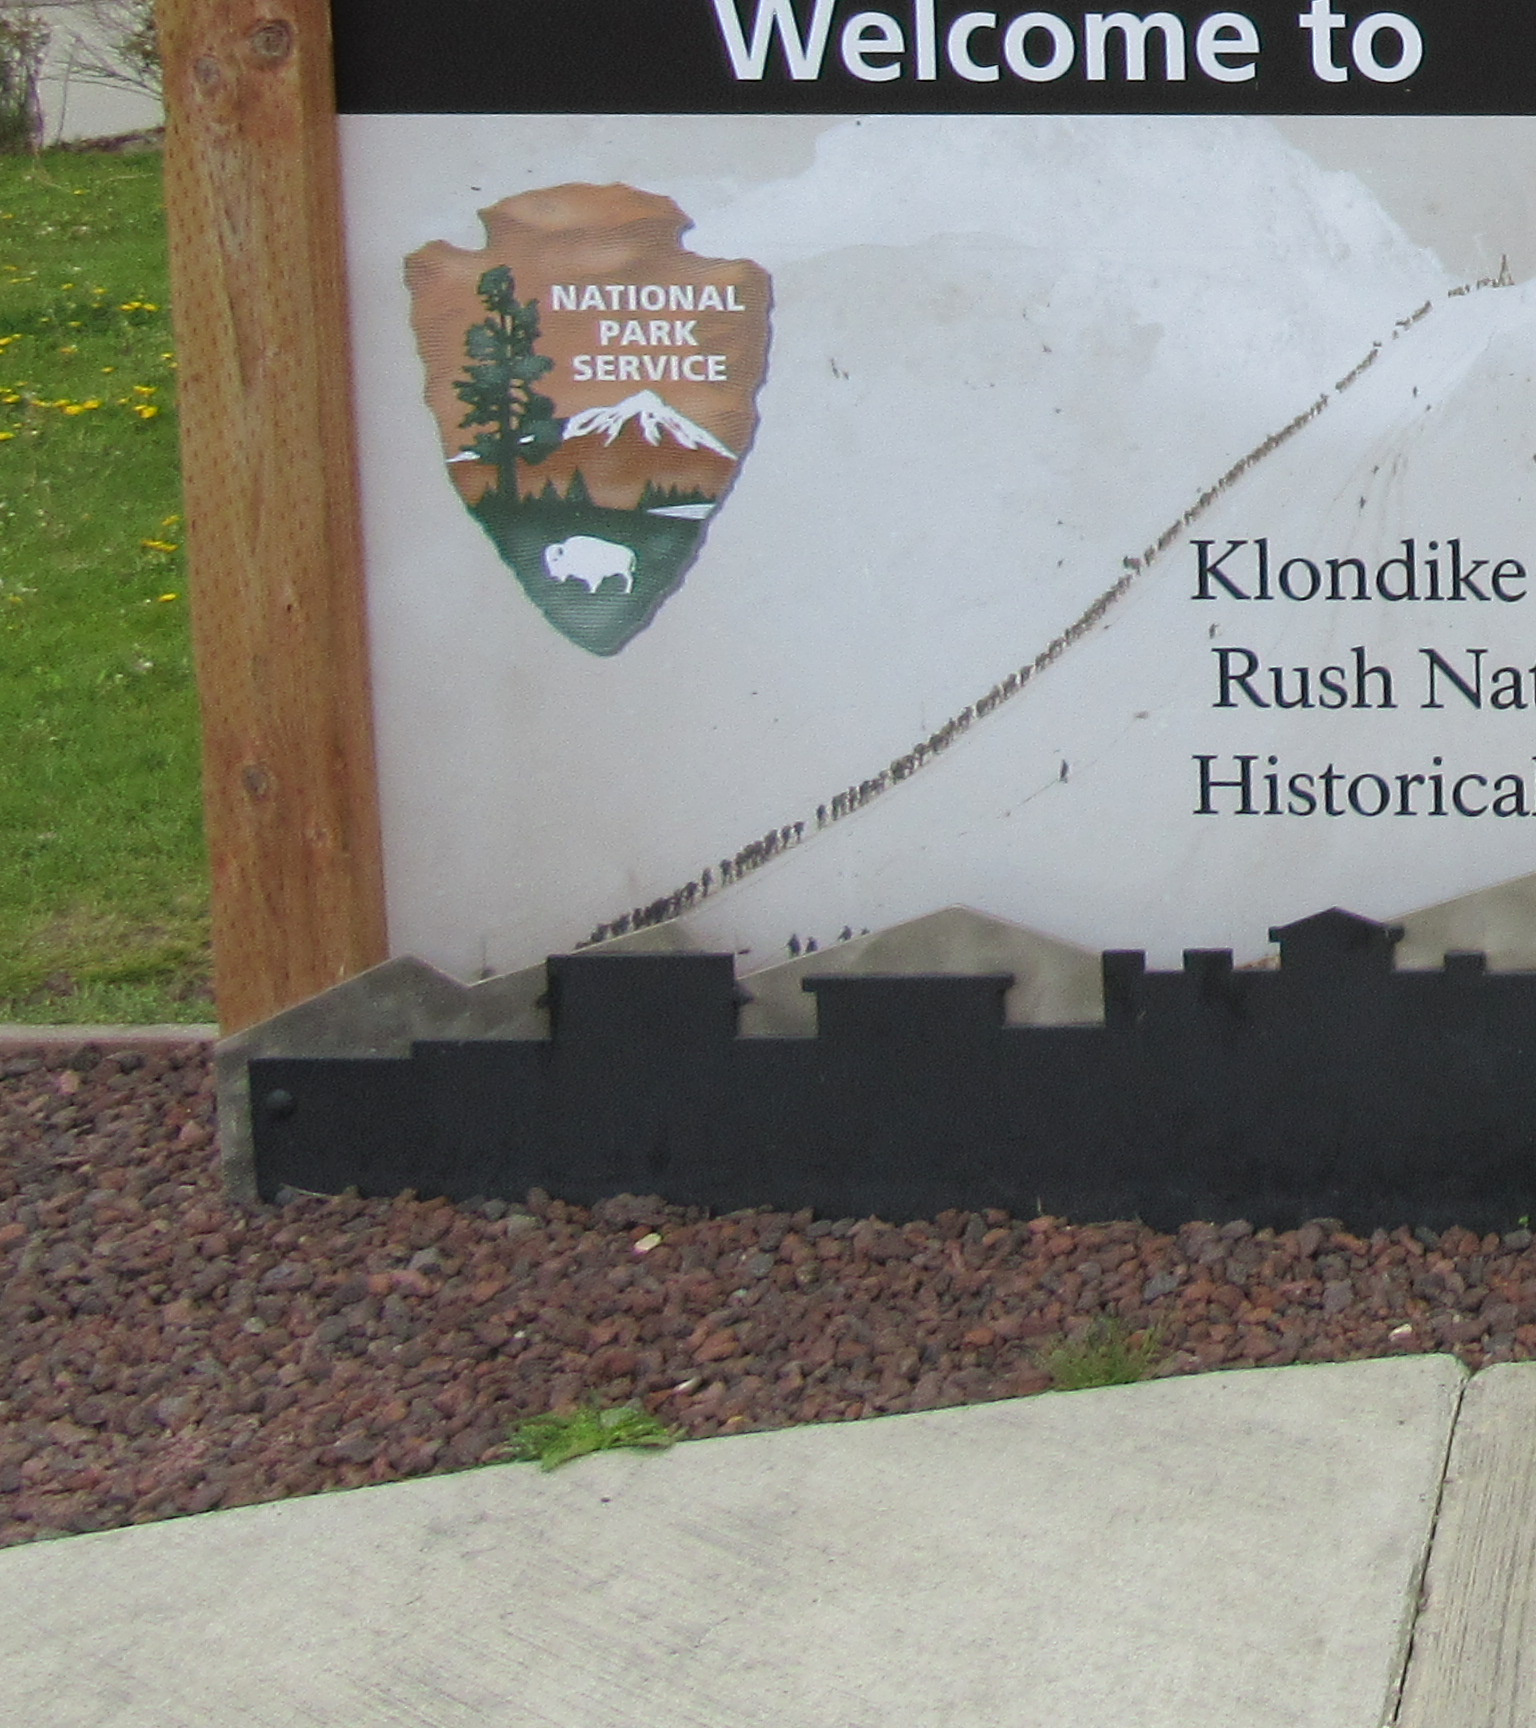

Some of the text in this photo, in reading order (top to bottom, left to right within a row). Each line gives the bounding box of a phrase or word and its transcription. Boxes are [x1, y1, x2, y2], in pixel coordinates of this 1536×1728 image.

[550, 284, 746, 312] NATIONAL
[599, 319, 700, 347] PARK
[572, 354, 728, 382] SERVICE
[1189, 537, 1528, 603] Klondike
[1211, 645, 1399, 710] Rush
